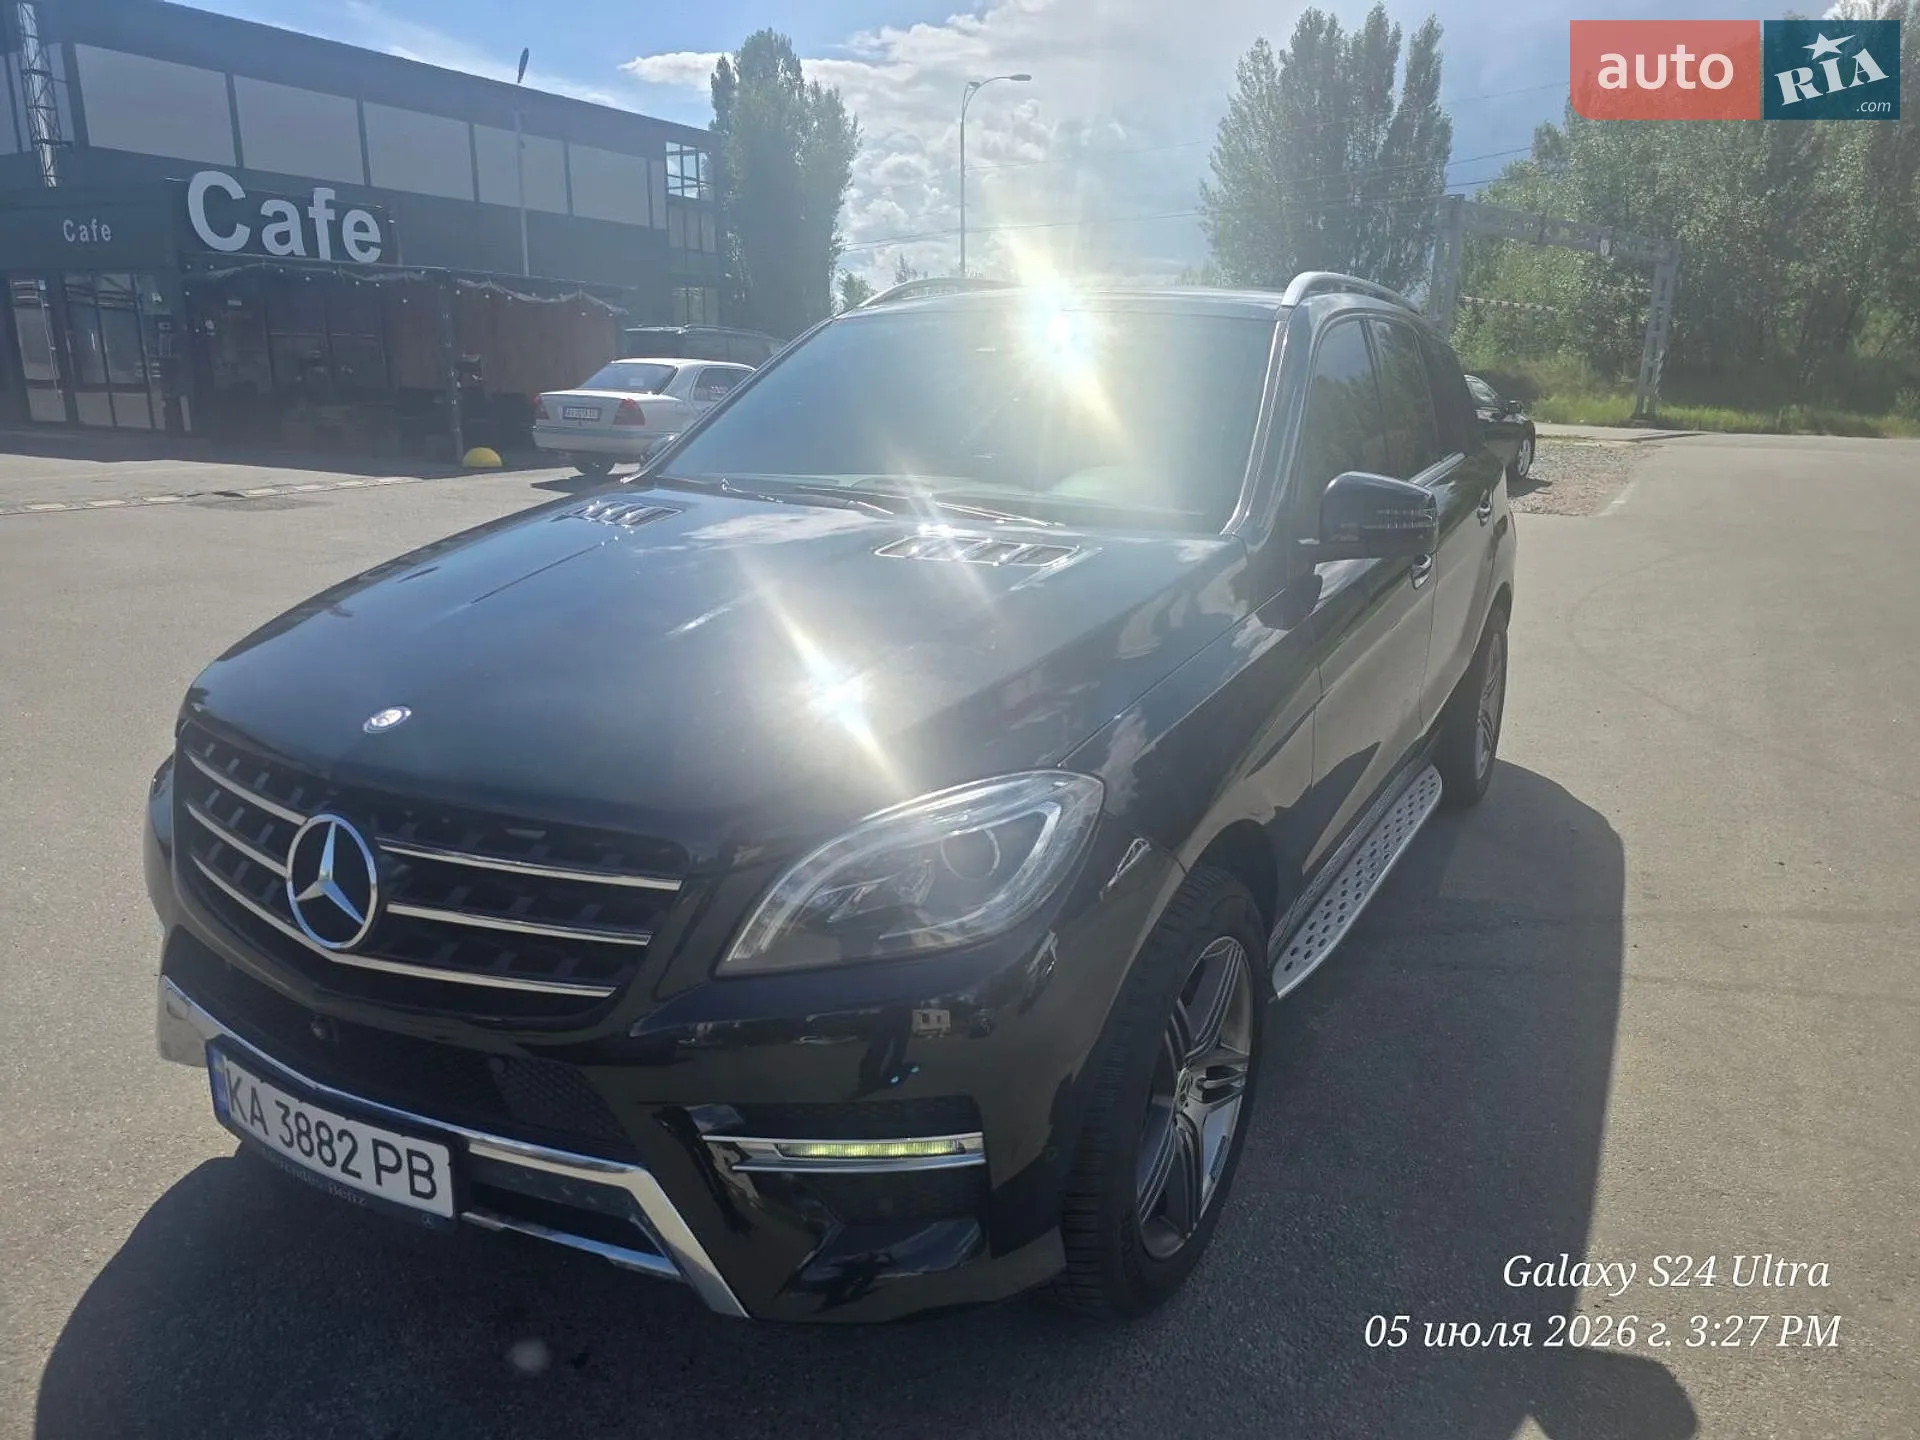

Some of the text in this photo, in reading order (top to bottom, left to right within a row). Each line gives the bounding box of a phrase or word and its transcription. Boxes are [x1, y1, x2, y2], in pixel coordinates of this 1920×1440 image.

[63, 219, 112, 243] Cafe
[187, 170, 382, 264] Cafe
[226, 1066, 437, 1200] KA 3882 PB
